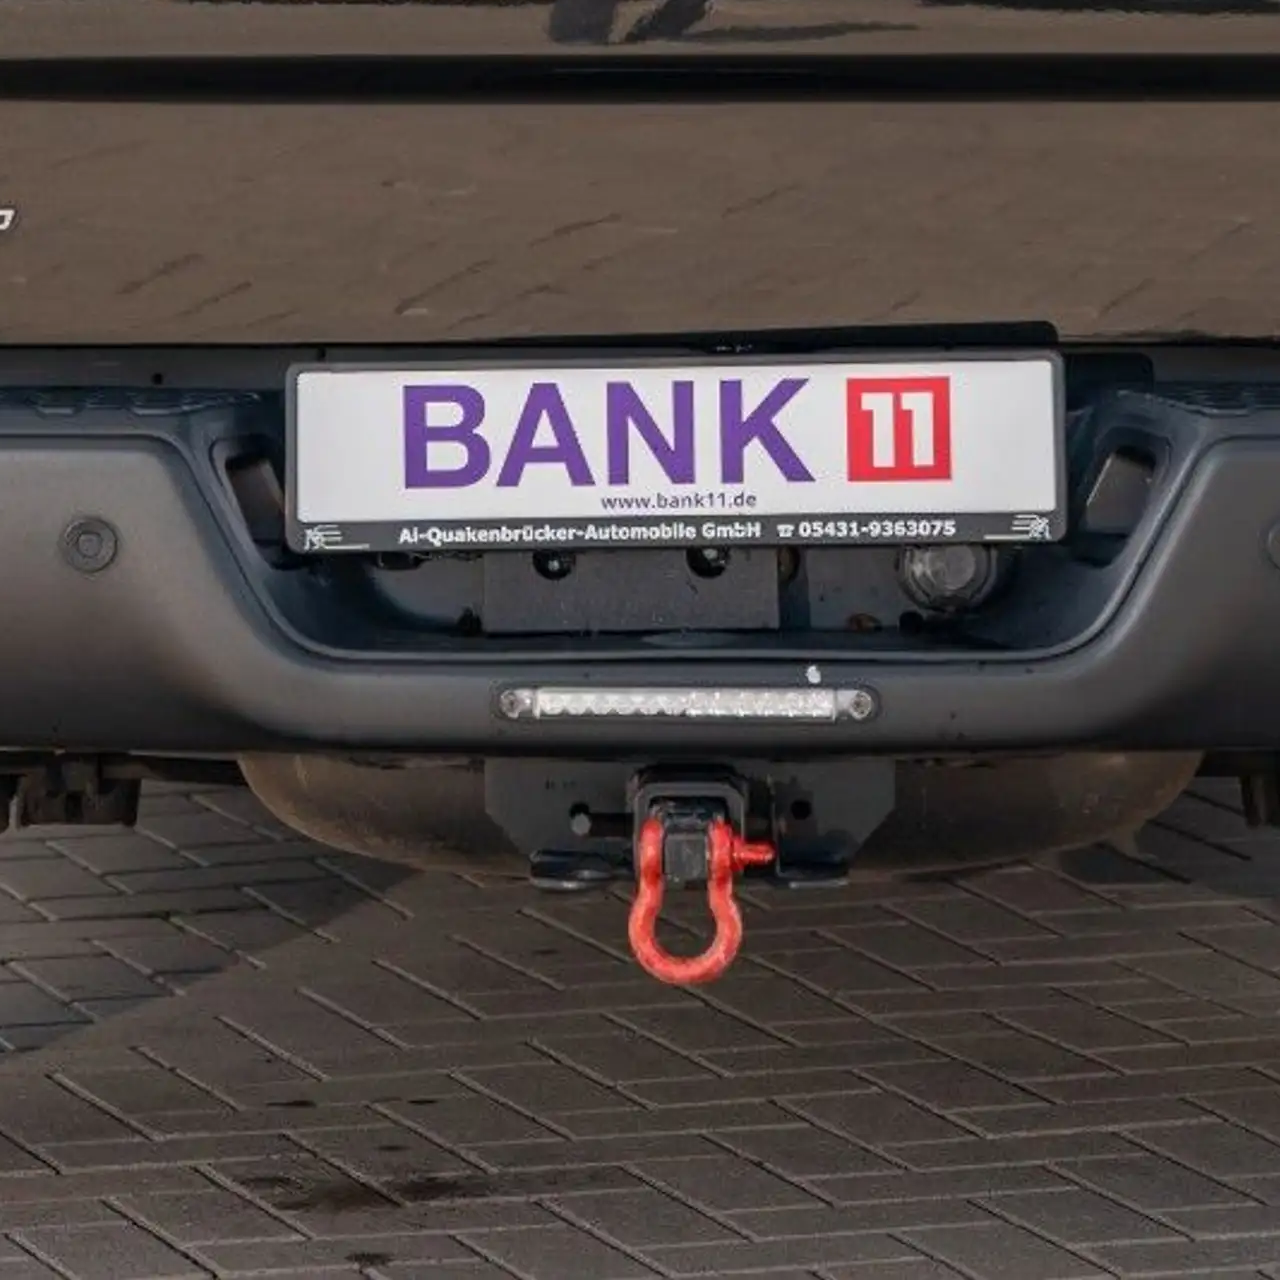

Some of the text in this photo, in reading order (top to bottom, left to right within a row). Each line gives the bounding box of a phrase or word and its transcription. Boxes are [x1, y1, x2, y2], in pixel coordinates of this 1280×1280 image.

[402, 378, 937, 489] BANK 11
[601, 491, 757, 511] www.bank11.de
[701, 522, 761, 539] GmbH
[798, 519, 957, 538] 05431-9363075
